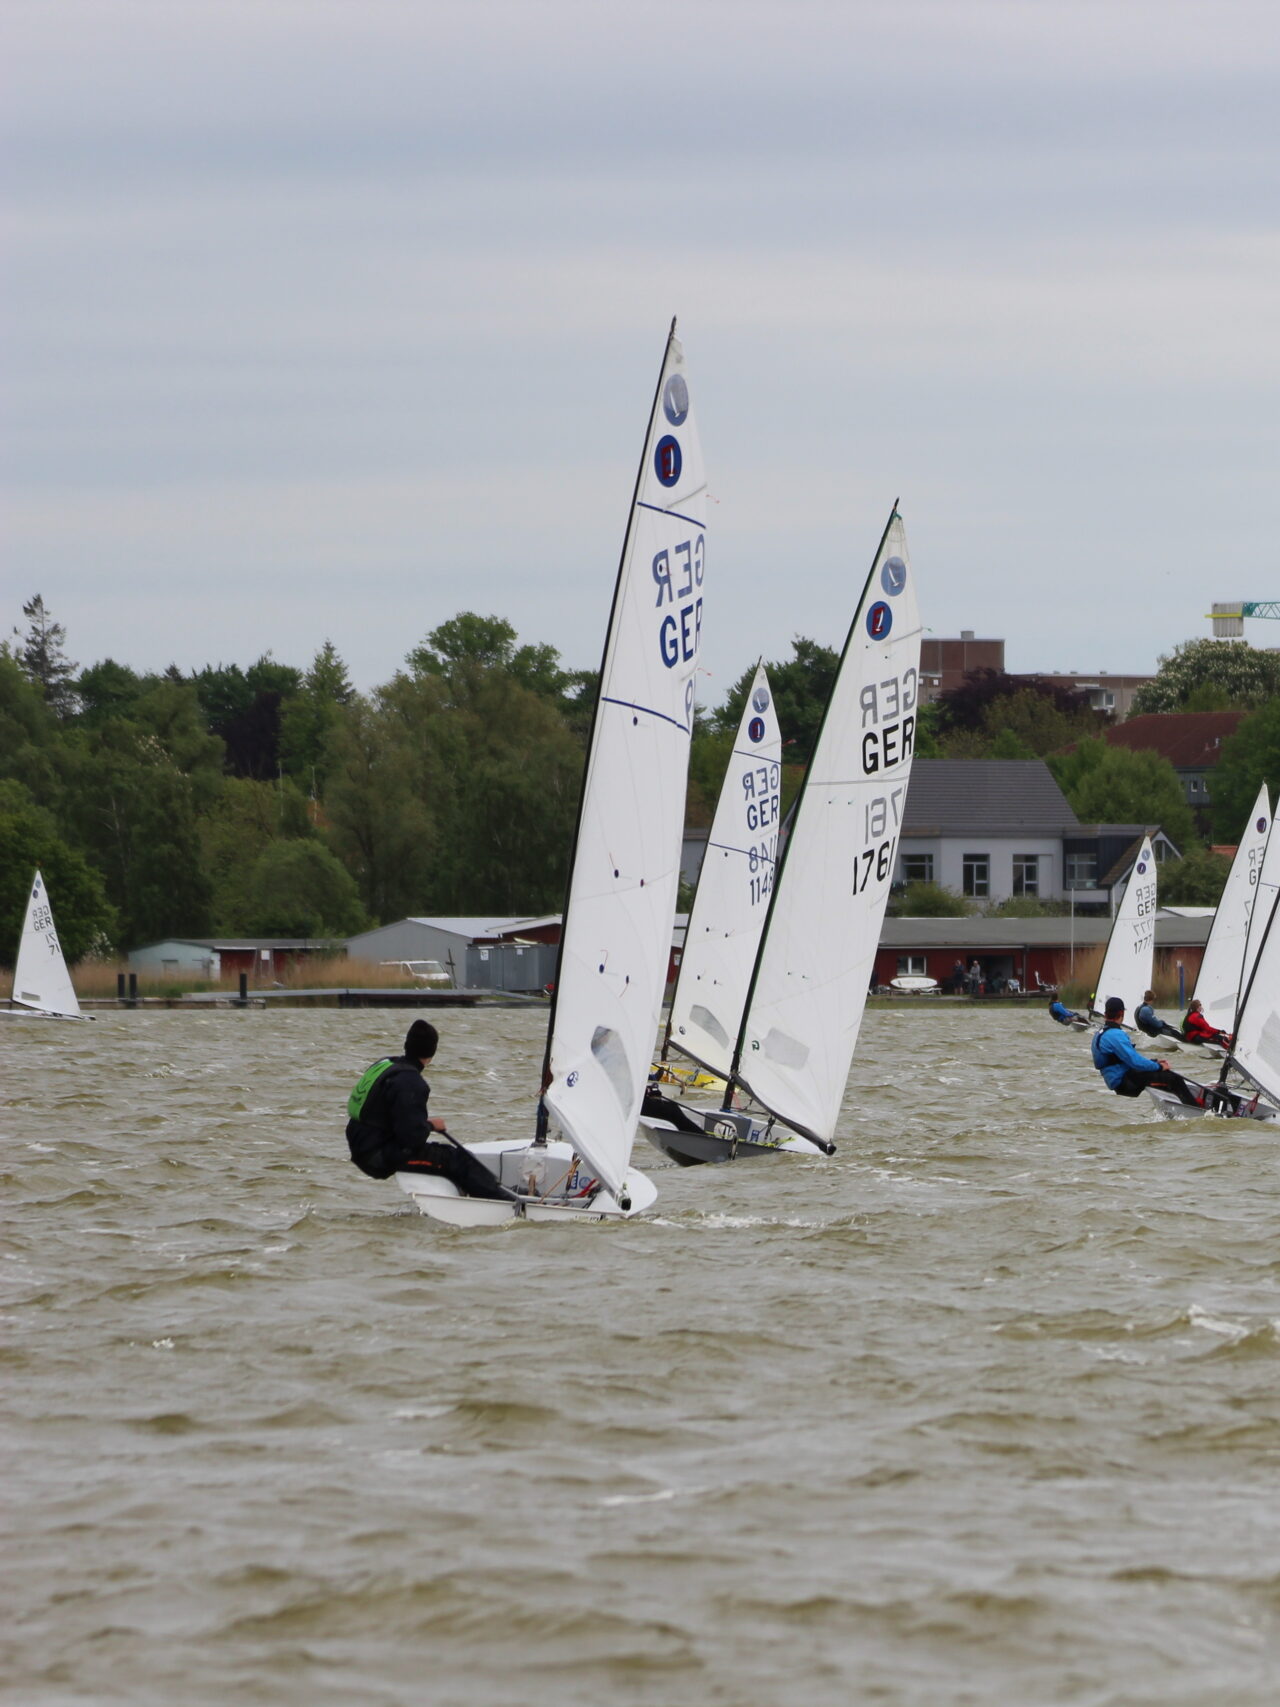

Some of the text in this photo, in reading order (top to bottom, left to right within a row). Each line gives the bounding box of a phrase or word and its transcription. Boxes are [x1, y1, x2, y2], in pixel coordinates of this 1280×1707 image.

[660, 597, 703, 669] GER
[862, 716, 914, 775] GER
[747, 795, 778, 831] GER
[853, 836, 896, 896] 1761
[34, 916, 52, 931] GER
[1137, 898, 1156, 917] GER
[48, 943, 60, 955] 71
